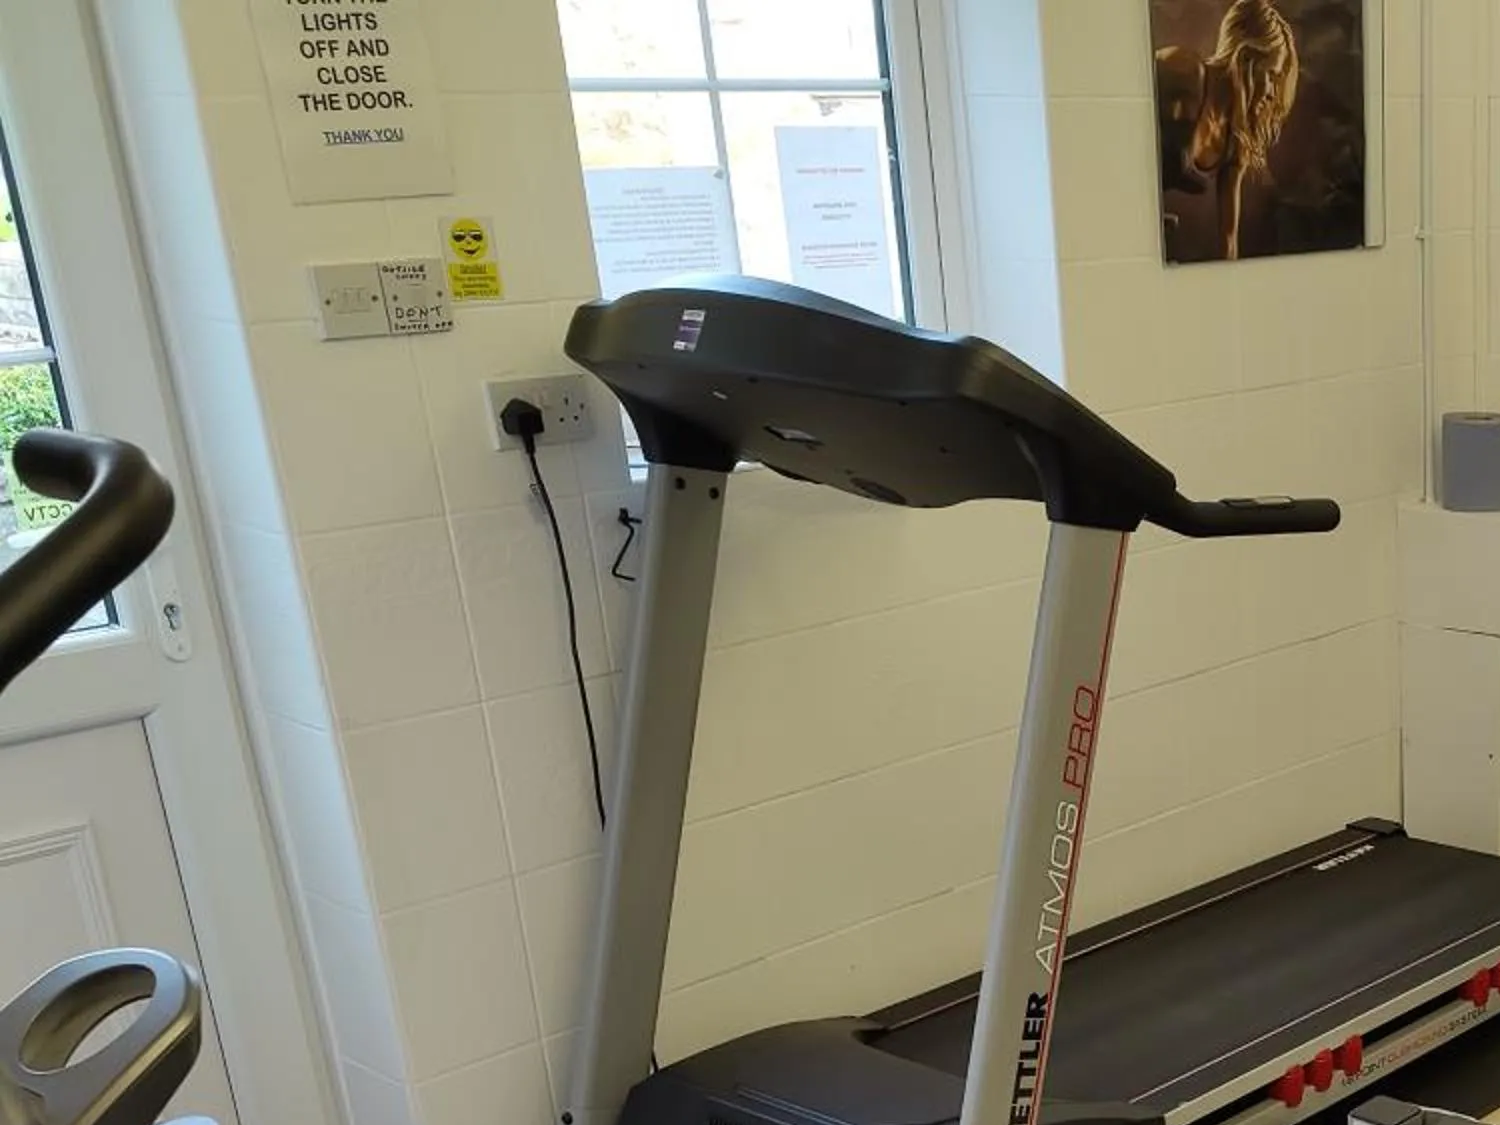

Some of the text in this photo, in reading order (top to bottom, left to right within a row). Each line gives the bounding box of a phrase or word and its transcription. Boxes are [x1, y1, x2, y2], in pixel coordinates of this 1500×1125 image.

[301, 12, 378, 31] LIGHTS
[300, 39, 389, 58] OFF AND
[317, 66, 387, 85] CLOSE
[298, 91, 413, 112] THE DOOR.
[322, 127, 404, 145] THANK YOU
[1035, 800, 1079, 974] ATMOS
[1062, 685, 1096, 789] PRO
